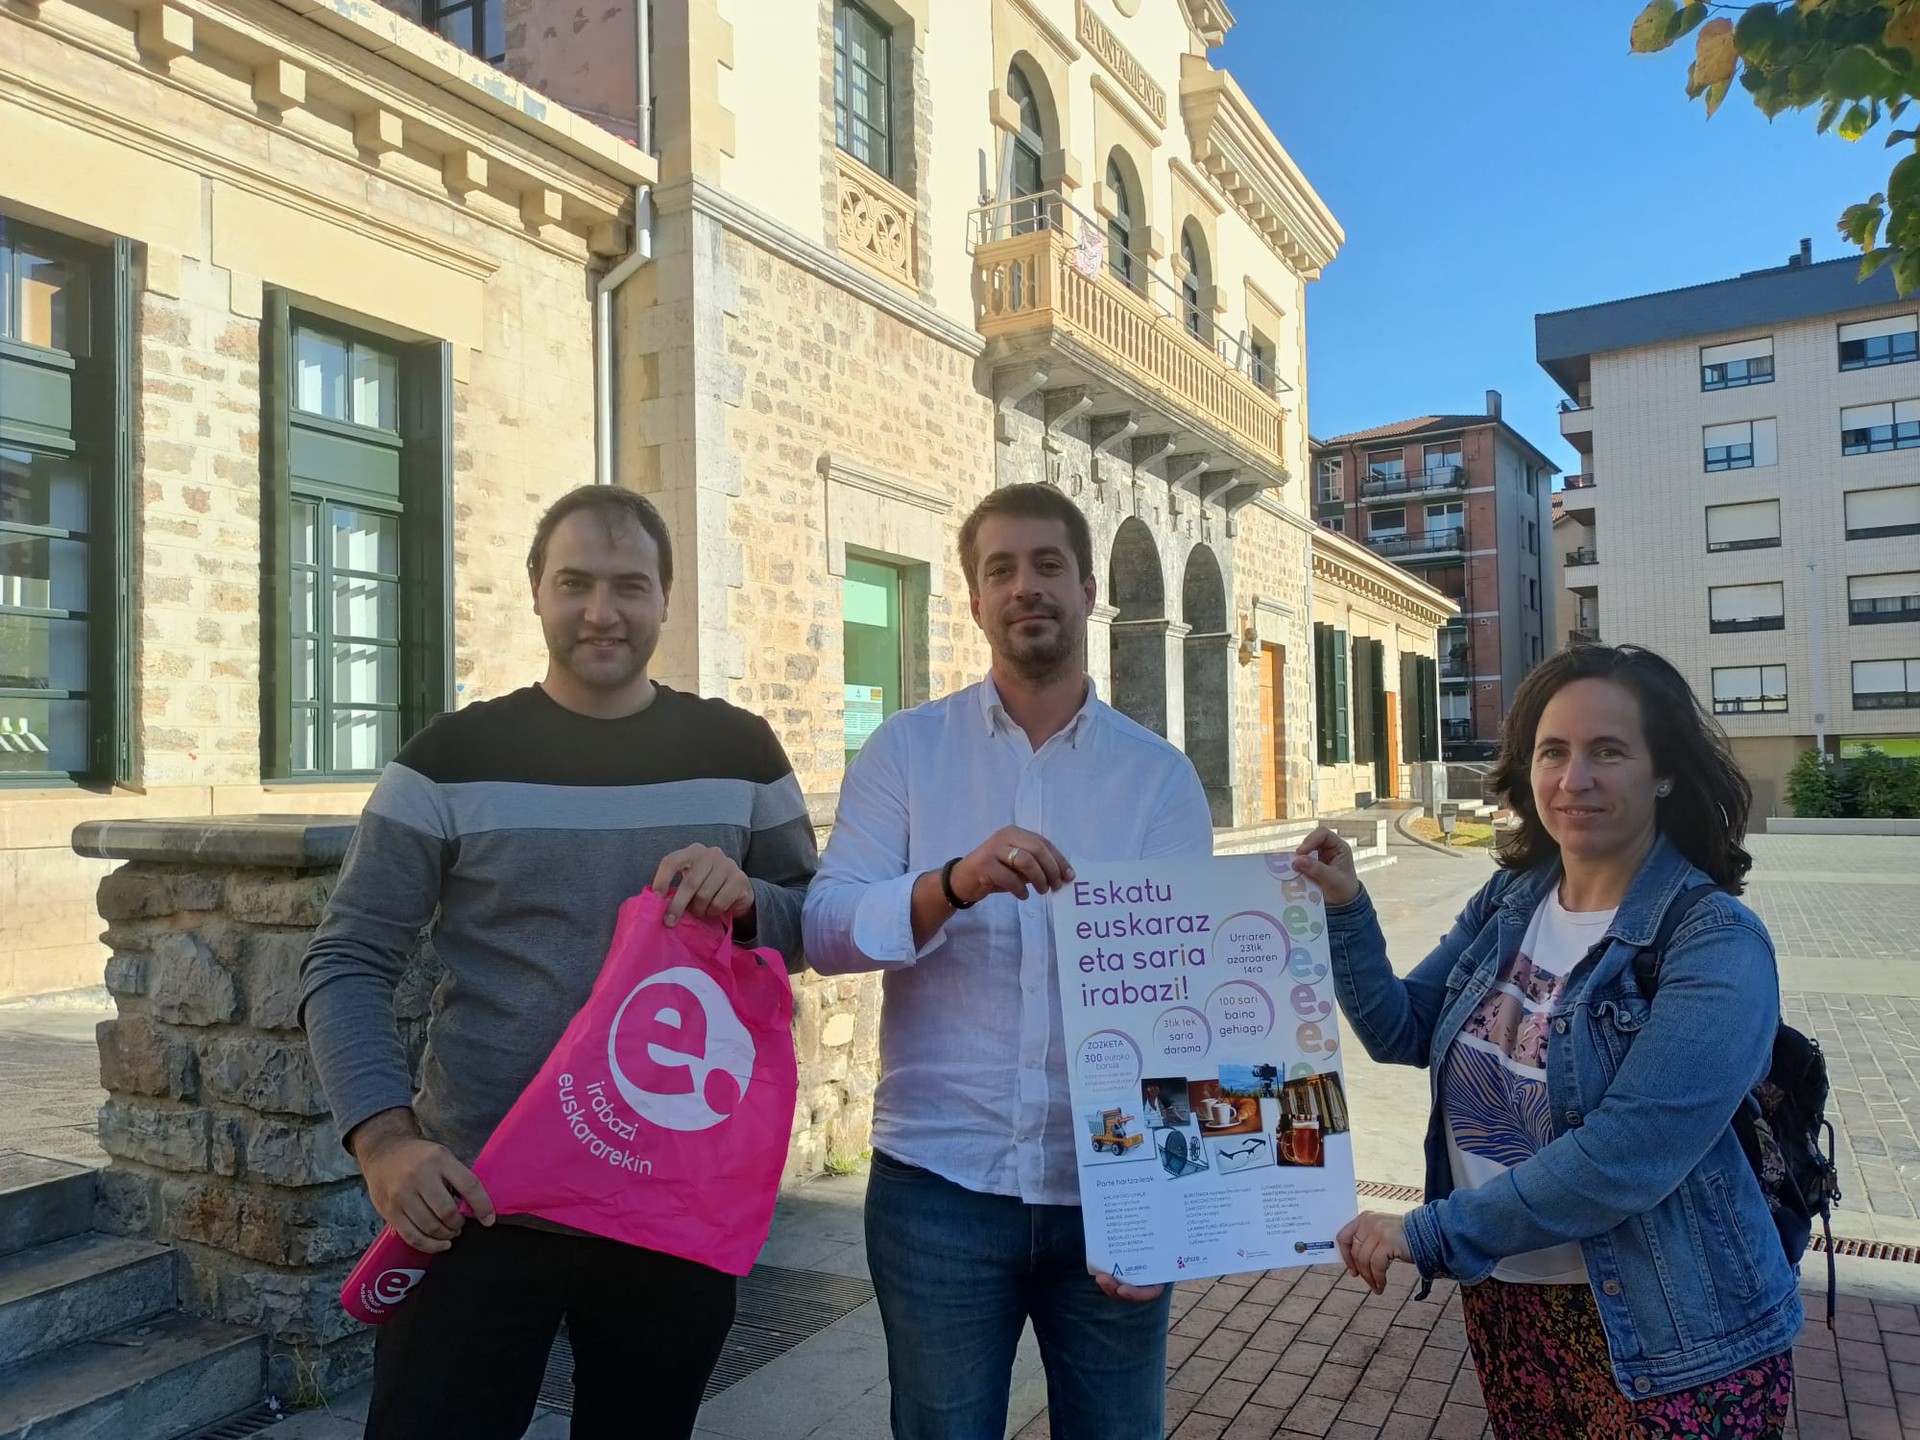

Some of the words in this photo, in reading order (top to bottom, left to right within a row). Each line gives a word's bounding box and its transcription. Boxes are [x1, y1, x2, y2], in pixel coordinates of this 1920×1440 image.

[1083, 9, 1165, 119] AYUNTAMIENTO
[1074, 878, 1172, 906] Eskatu
[1076, 912, 1211, 940] euskaraz
[1230, 932, 1271, 942] Urriaren
[1240, 943, 1263, 953] 23tik
[1078, 947, 1124, 974] eta
[1133, 943, 1206, 971] saria
[1227, 953, 1278, 965] azaroaren
[1243, 965, 1263, 975] 14ra
[1082, 976, 1189, 1007] irabazi!
[1219, 996, 1236, 1006] 100
[1238, 994, 1259, 1005] sari
[1225, 1008, 1256, 1020] baino
[1219, 1022, 1264, 1036] gehiago
[1169, 1032, 1194, 1041] saria
[1088, 1040, 1124, 1049] ZOZKETA
[1164, 1045, 1201, 1055] darama
[1084, 1054, 1102, 1063] 300
[586, 1080, 640, 1141] irabazi
[558, 1073, 653, 1176] euskararekin
[1096, 1179, 1115, 1188] Parte
